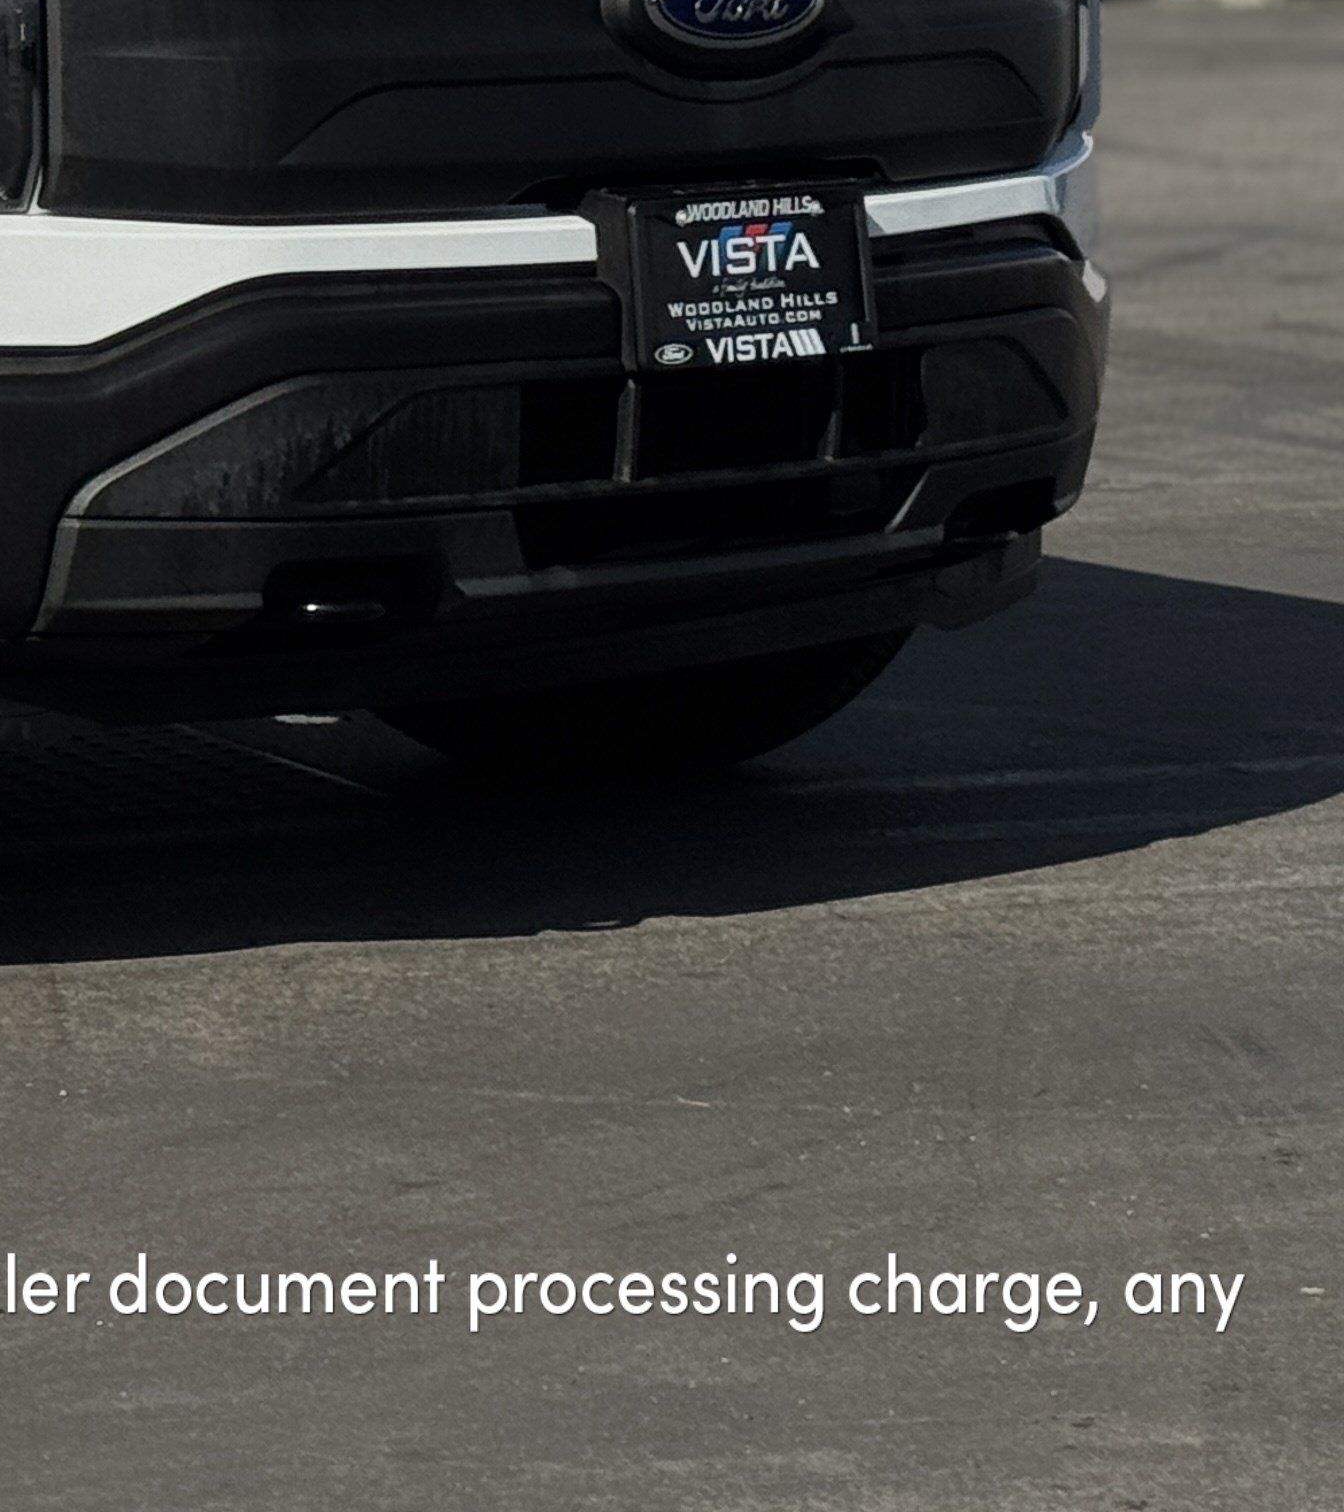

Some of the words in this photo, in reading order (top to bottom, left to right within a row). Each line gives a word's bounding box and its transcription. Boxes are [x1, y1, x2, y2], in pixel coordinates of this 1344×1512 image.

[685, 199, 770, 223] WOODLAND
[772, 195, 813, 215] HILLS
[676, 232, 821, 278] VISTA
[705, 331, 796, 364] VISTA
